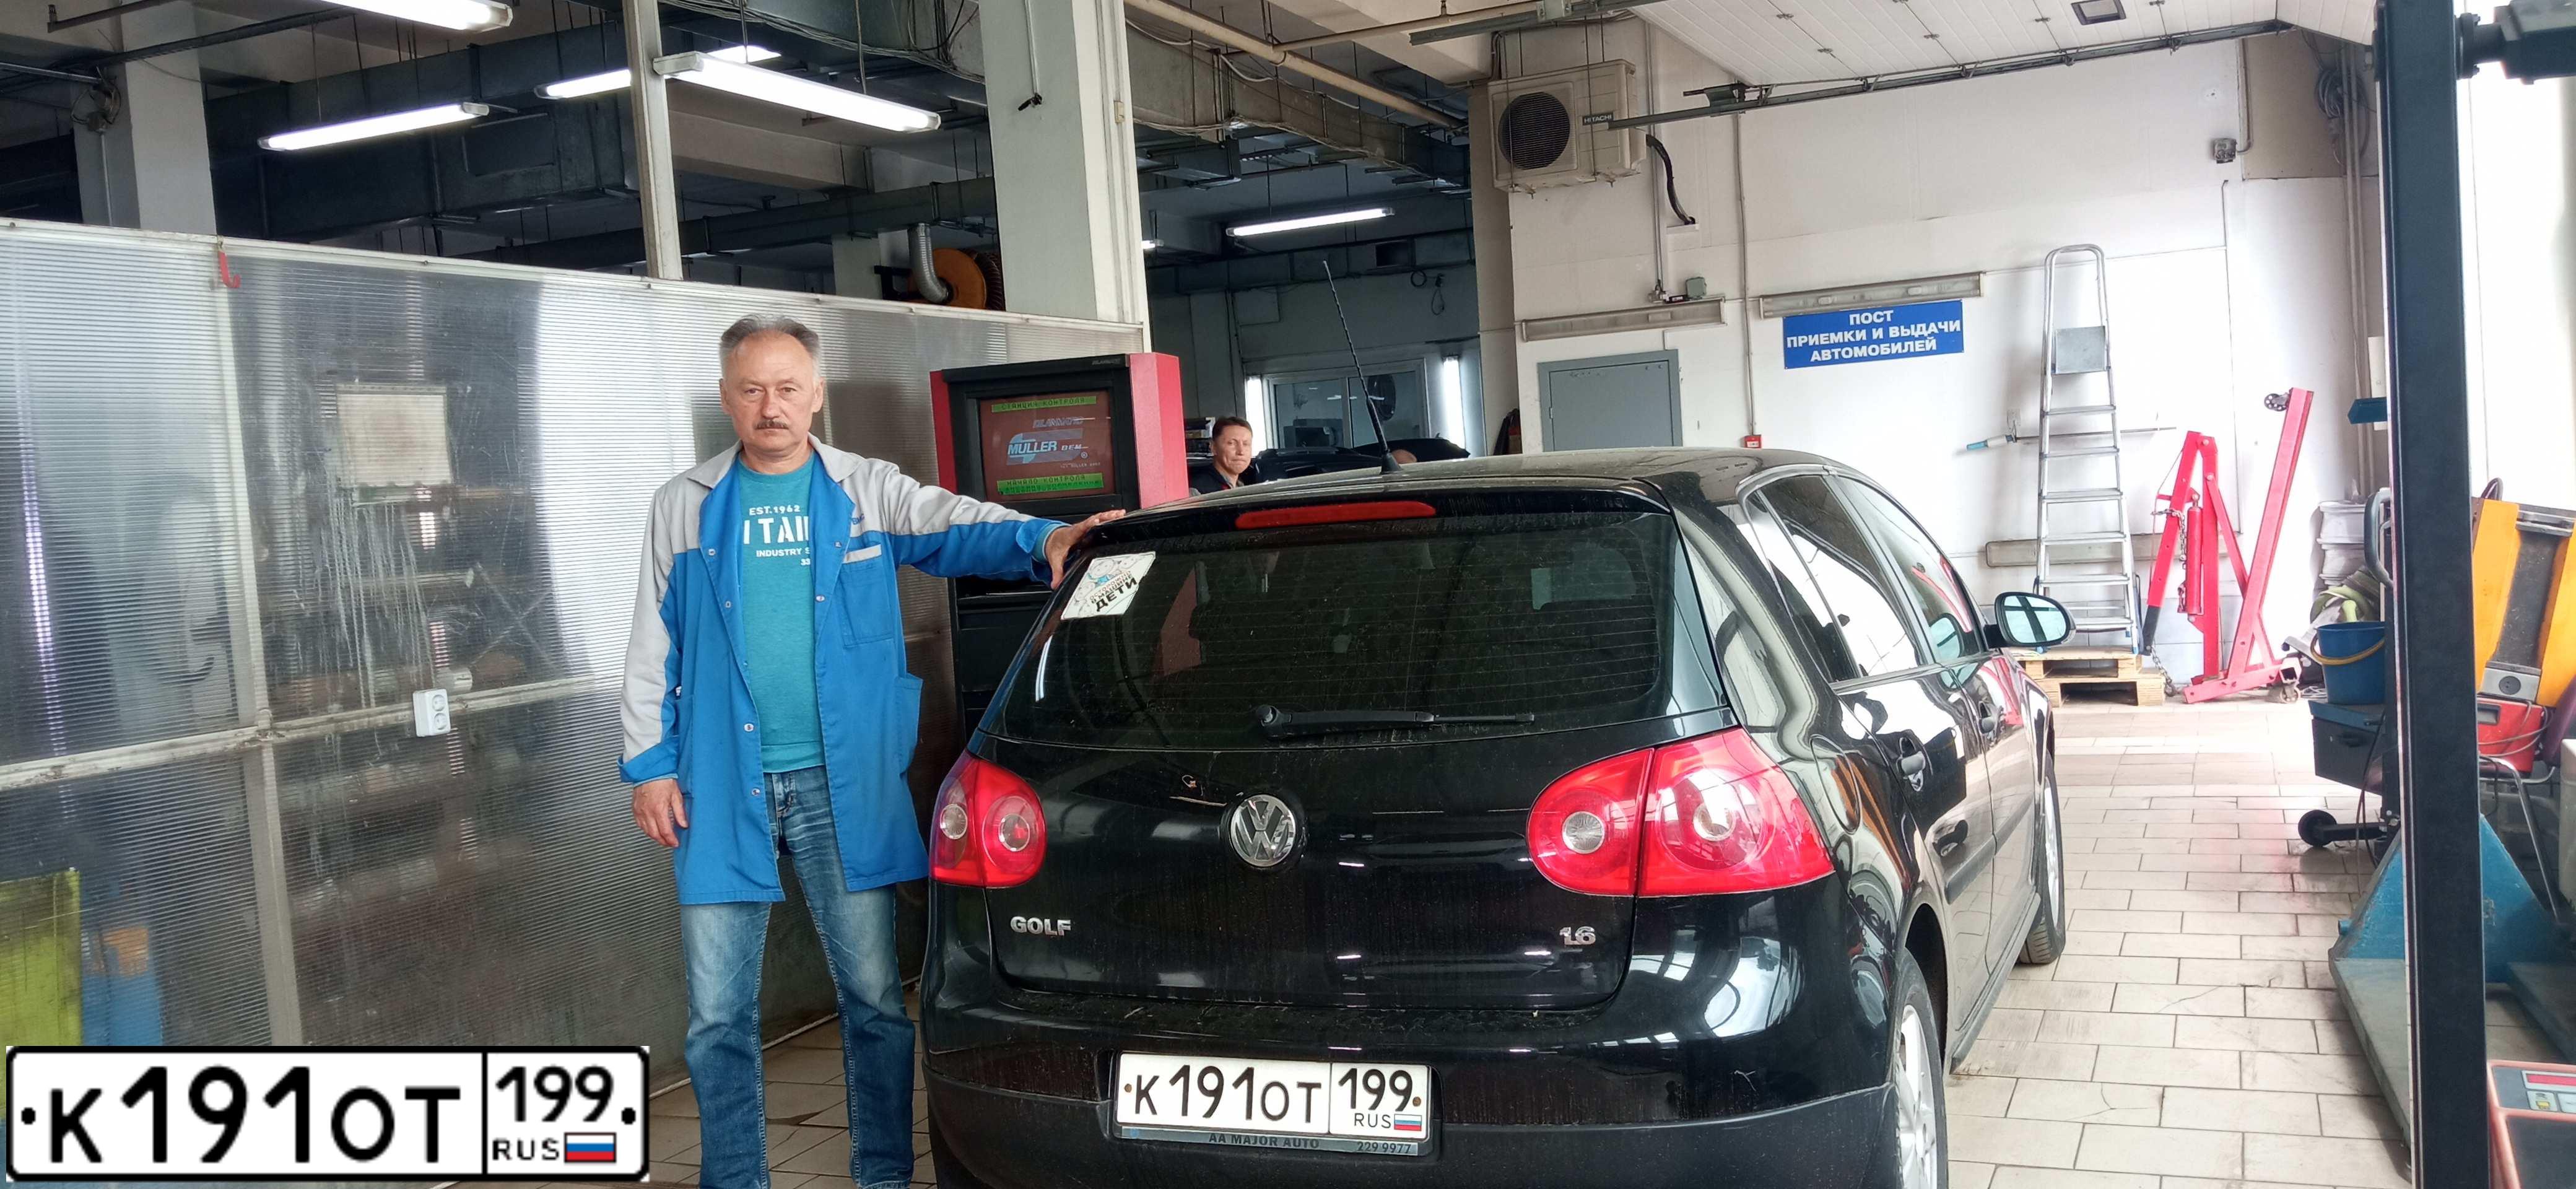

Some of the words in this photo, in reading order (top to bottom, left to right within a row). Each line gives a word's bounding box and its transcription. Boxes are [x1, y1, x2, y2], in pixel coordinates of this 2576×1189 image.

[1584, 114, 1612, 123] HITACHI
[1849, 310, 1894, 326] ПОСТ
[1786, 329, 1867, 348] ПРИЕМКИ
[1872, 327, 1884, 340] И
[1889, 320, 1961, 338] ВЫДАЧИ
[1810, 337, 1937, 362] АВТОМОБИЛЕЙ
[1007, 440, 1058, 455] MULLER
[756, 548, 802, 557] INDUSTRY
[1096, 577, 1137, 612] ДЕТИ
[1011, 916, 1071, 936] GOLF
[1338, 1068, 1413, 1112] 199
[1354, 1112, 1391, 1129] RUS
[1209, 1133, 1226, 1143] AA
[1231, 1135, 1278, 1147] MAJOR
[1282, 1138, 1320, 1149] AUTO
[1357, 1142, 1378, 1152] 229
[1382, 1143, 1412, 1154] 9977
